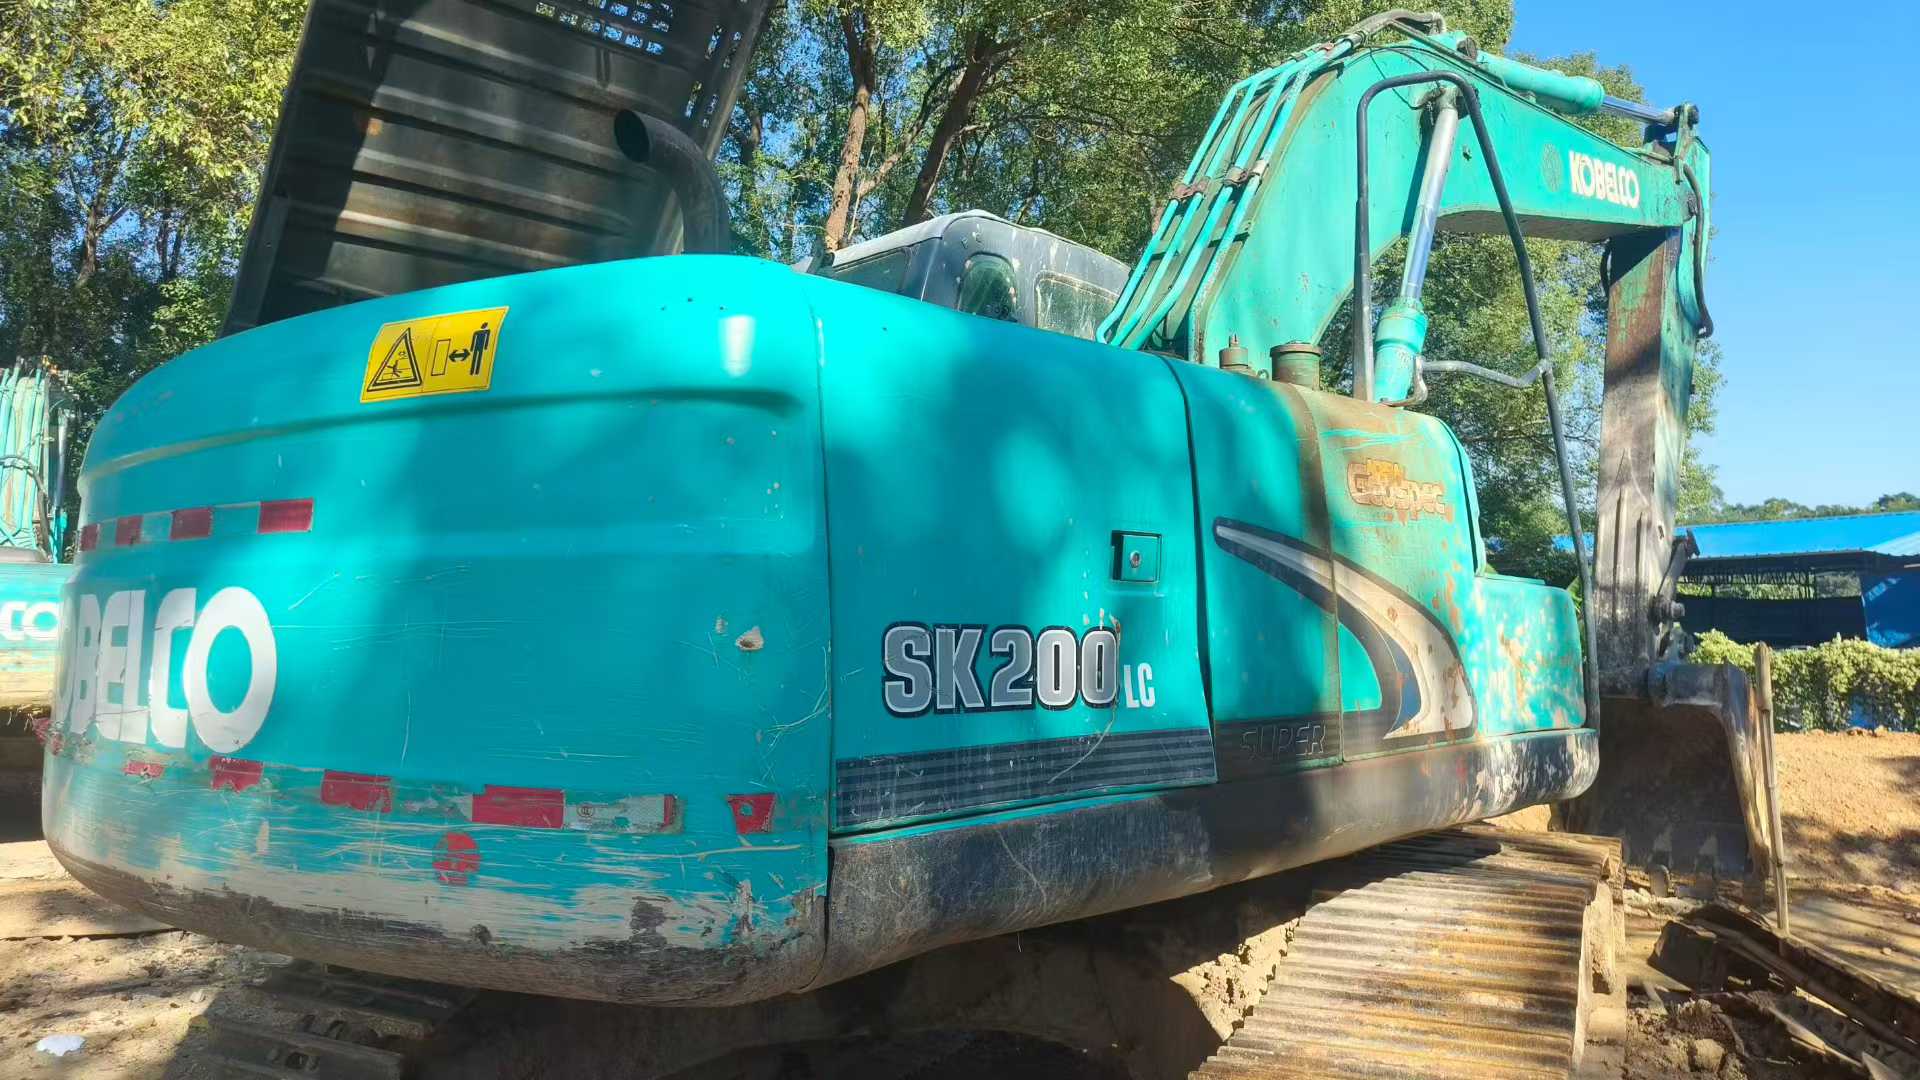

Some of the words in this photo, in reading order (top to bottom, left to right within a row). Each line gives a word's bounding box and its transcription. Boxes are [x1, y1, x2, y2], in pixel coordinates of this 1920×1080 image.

[1568, 150, 1640, 208] KOBELCO
[882, 621, 1120, 718] SK200
[1123, 662, 1156, 708] LC
[1240, 720, 1326, 761] SUPER
